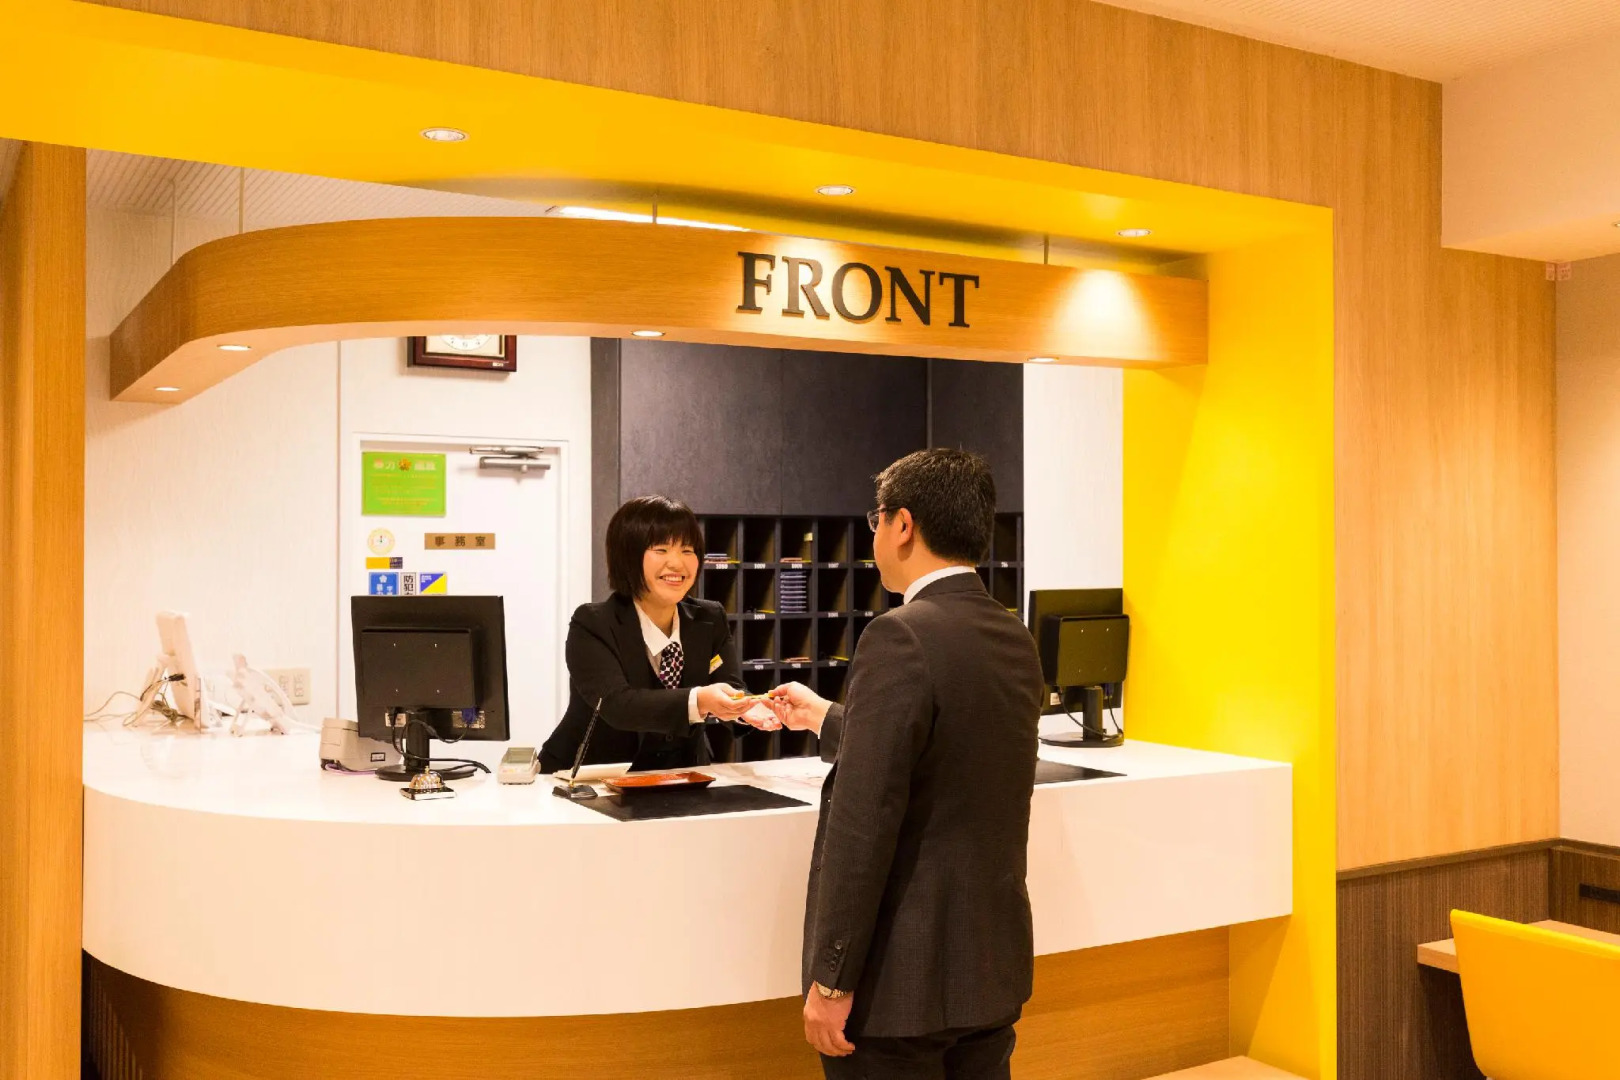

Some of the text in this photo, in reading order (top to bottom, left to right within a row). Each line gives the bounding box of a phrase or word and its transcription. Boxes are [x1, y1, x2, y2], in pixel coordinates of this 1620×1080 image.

[735, 251, 980, 328] FRONT
[434, 536, 486, 547] 事務室
